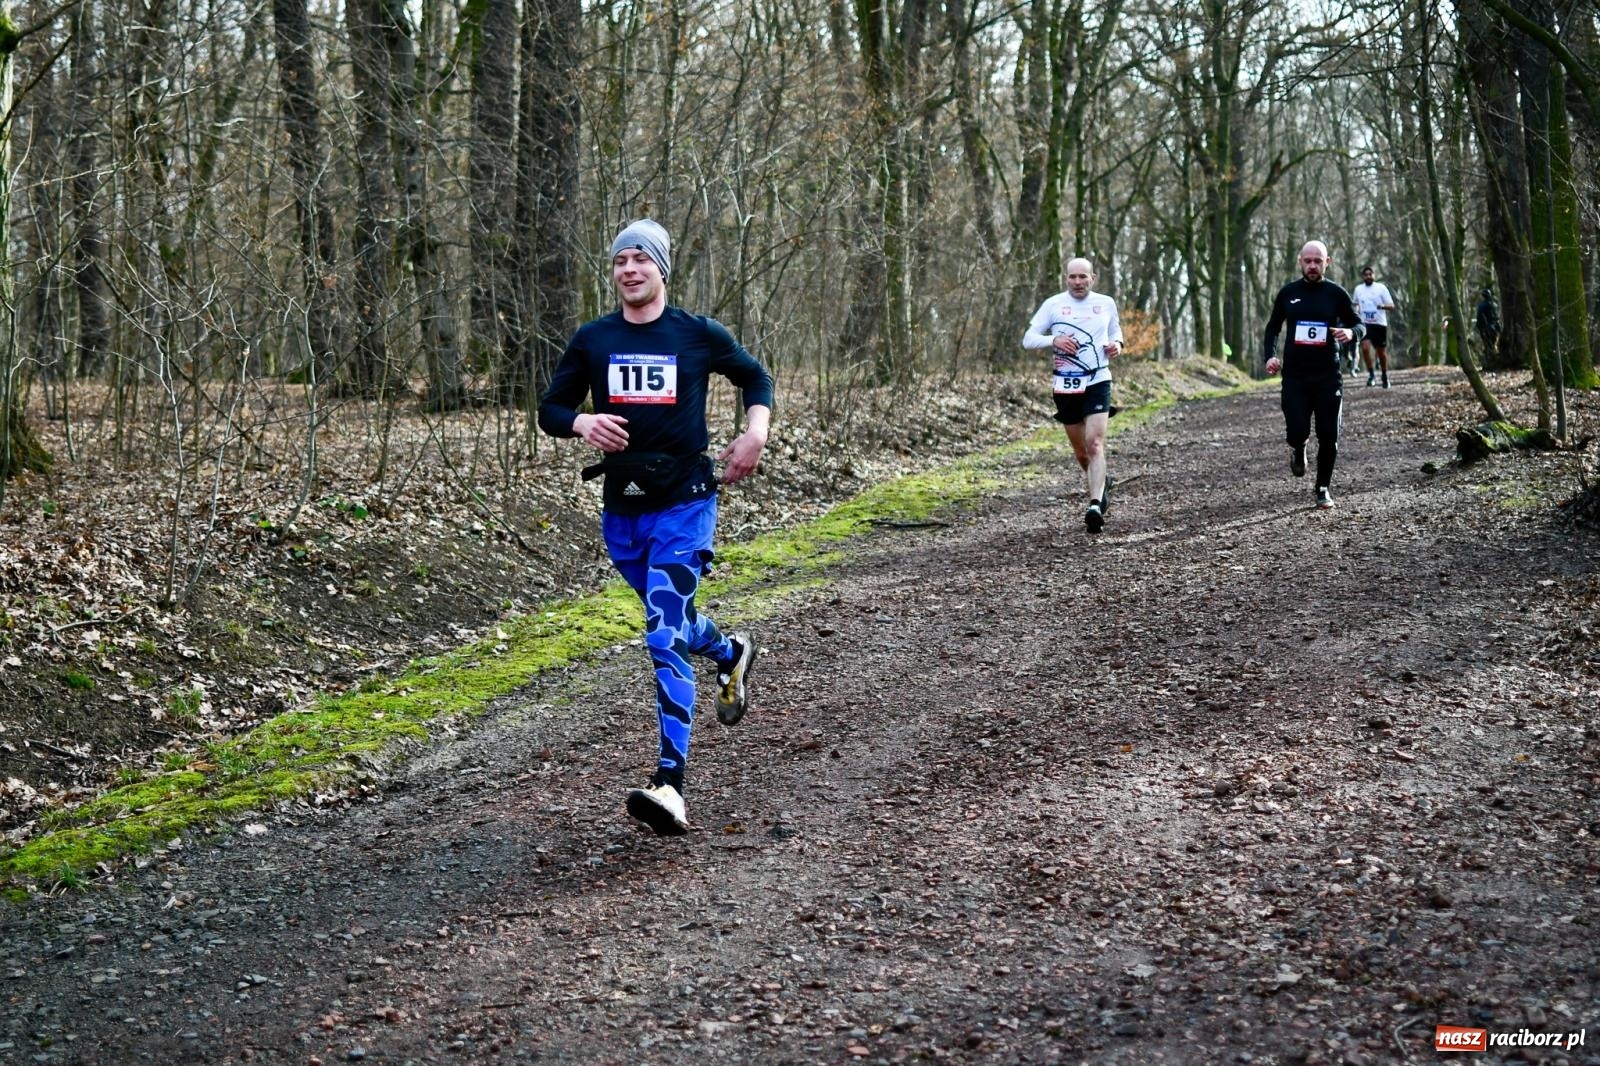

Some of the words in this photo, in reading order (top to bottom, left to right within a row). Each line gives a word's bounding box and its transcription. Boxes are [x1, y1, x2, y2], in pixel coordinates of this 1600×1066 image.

[1308, 327, 1317, 339] 6
[619, 366, 665, 391] 115
[1063, 377, 1081, 389] 59
